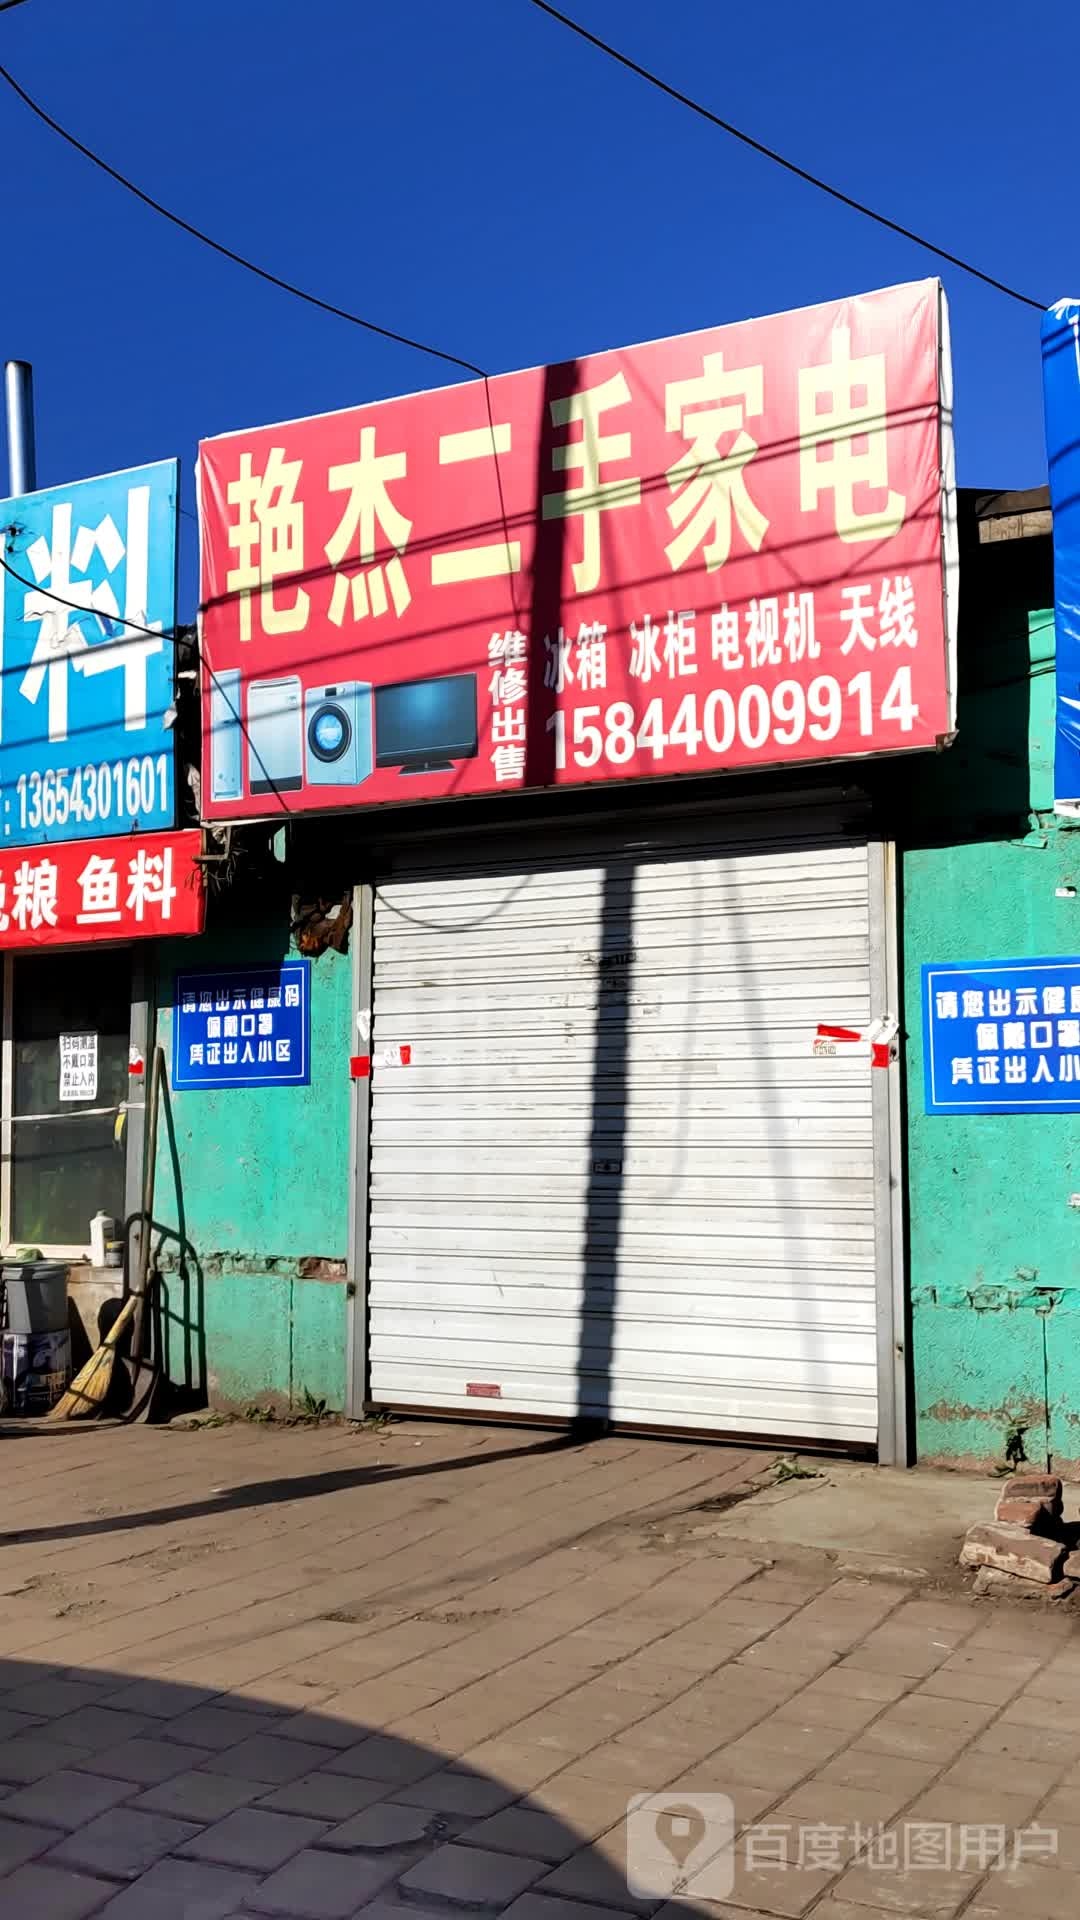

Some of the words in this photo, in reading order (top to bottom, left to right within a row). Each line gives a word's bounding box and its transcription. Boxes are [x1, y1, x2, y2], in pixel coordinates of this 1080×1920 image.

[226, 327, 906, 642] 艳杰二手家电
[544, 621, 607, 694] 冰箱
[629, 610, 698, 683] 冰柜
[710, 591, 820, 671] 电视机
[839, 575, 919, 656] 天线
[488, 630, 528, 781] 维修出售
[545, 666, 919, 769] 15844009914
[76, 847, 177, 924] 鱼料
[182, 984, 299, 1013] 请您出示健康码
